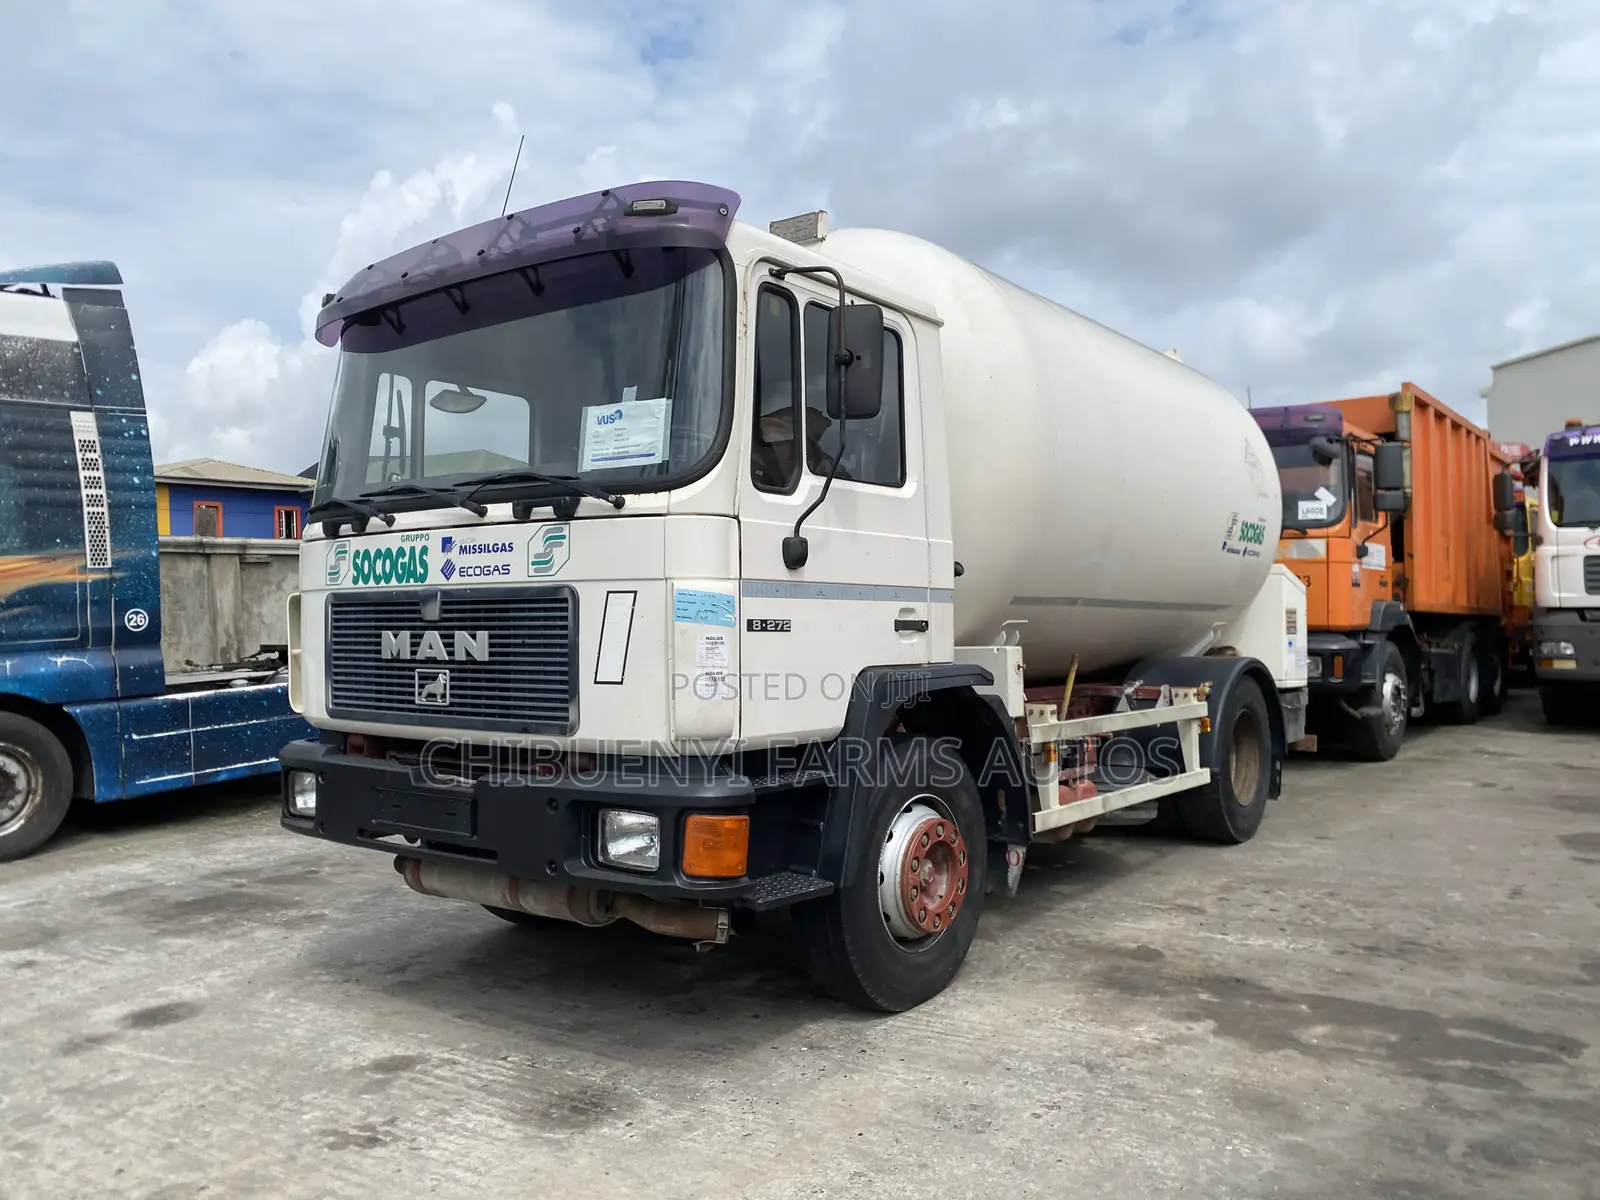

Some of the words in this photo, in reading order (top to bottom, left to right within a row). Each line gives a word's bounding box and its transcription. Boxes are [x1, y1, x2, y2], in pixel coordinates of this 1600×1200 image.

[597, 414, 615, 425] VUS
[400, 533, 430, 543] GRUPPO
[458, 542, 514, 556] MISSILGAS
[351, 545, 429, 586] SOCOGAS
[458, 563, 511, 578] ECOGAS
[128, 613, 146, 626] 26
[381, 630, 490, 662] MAN
